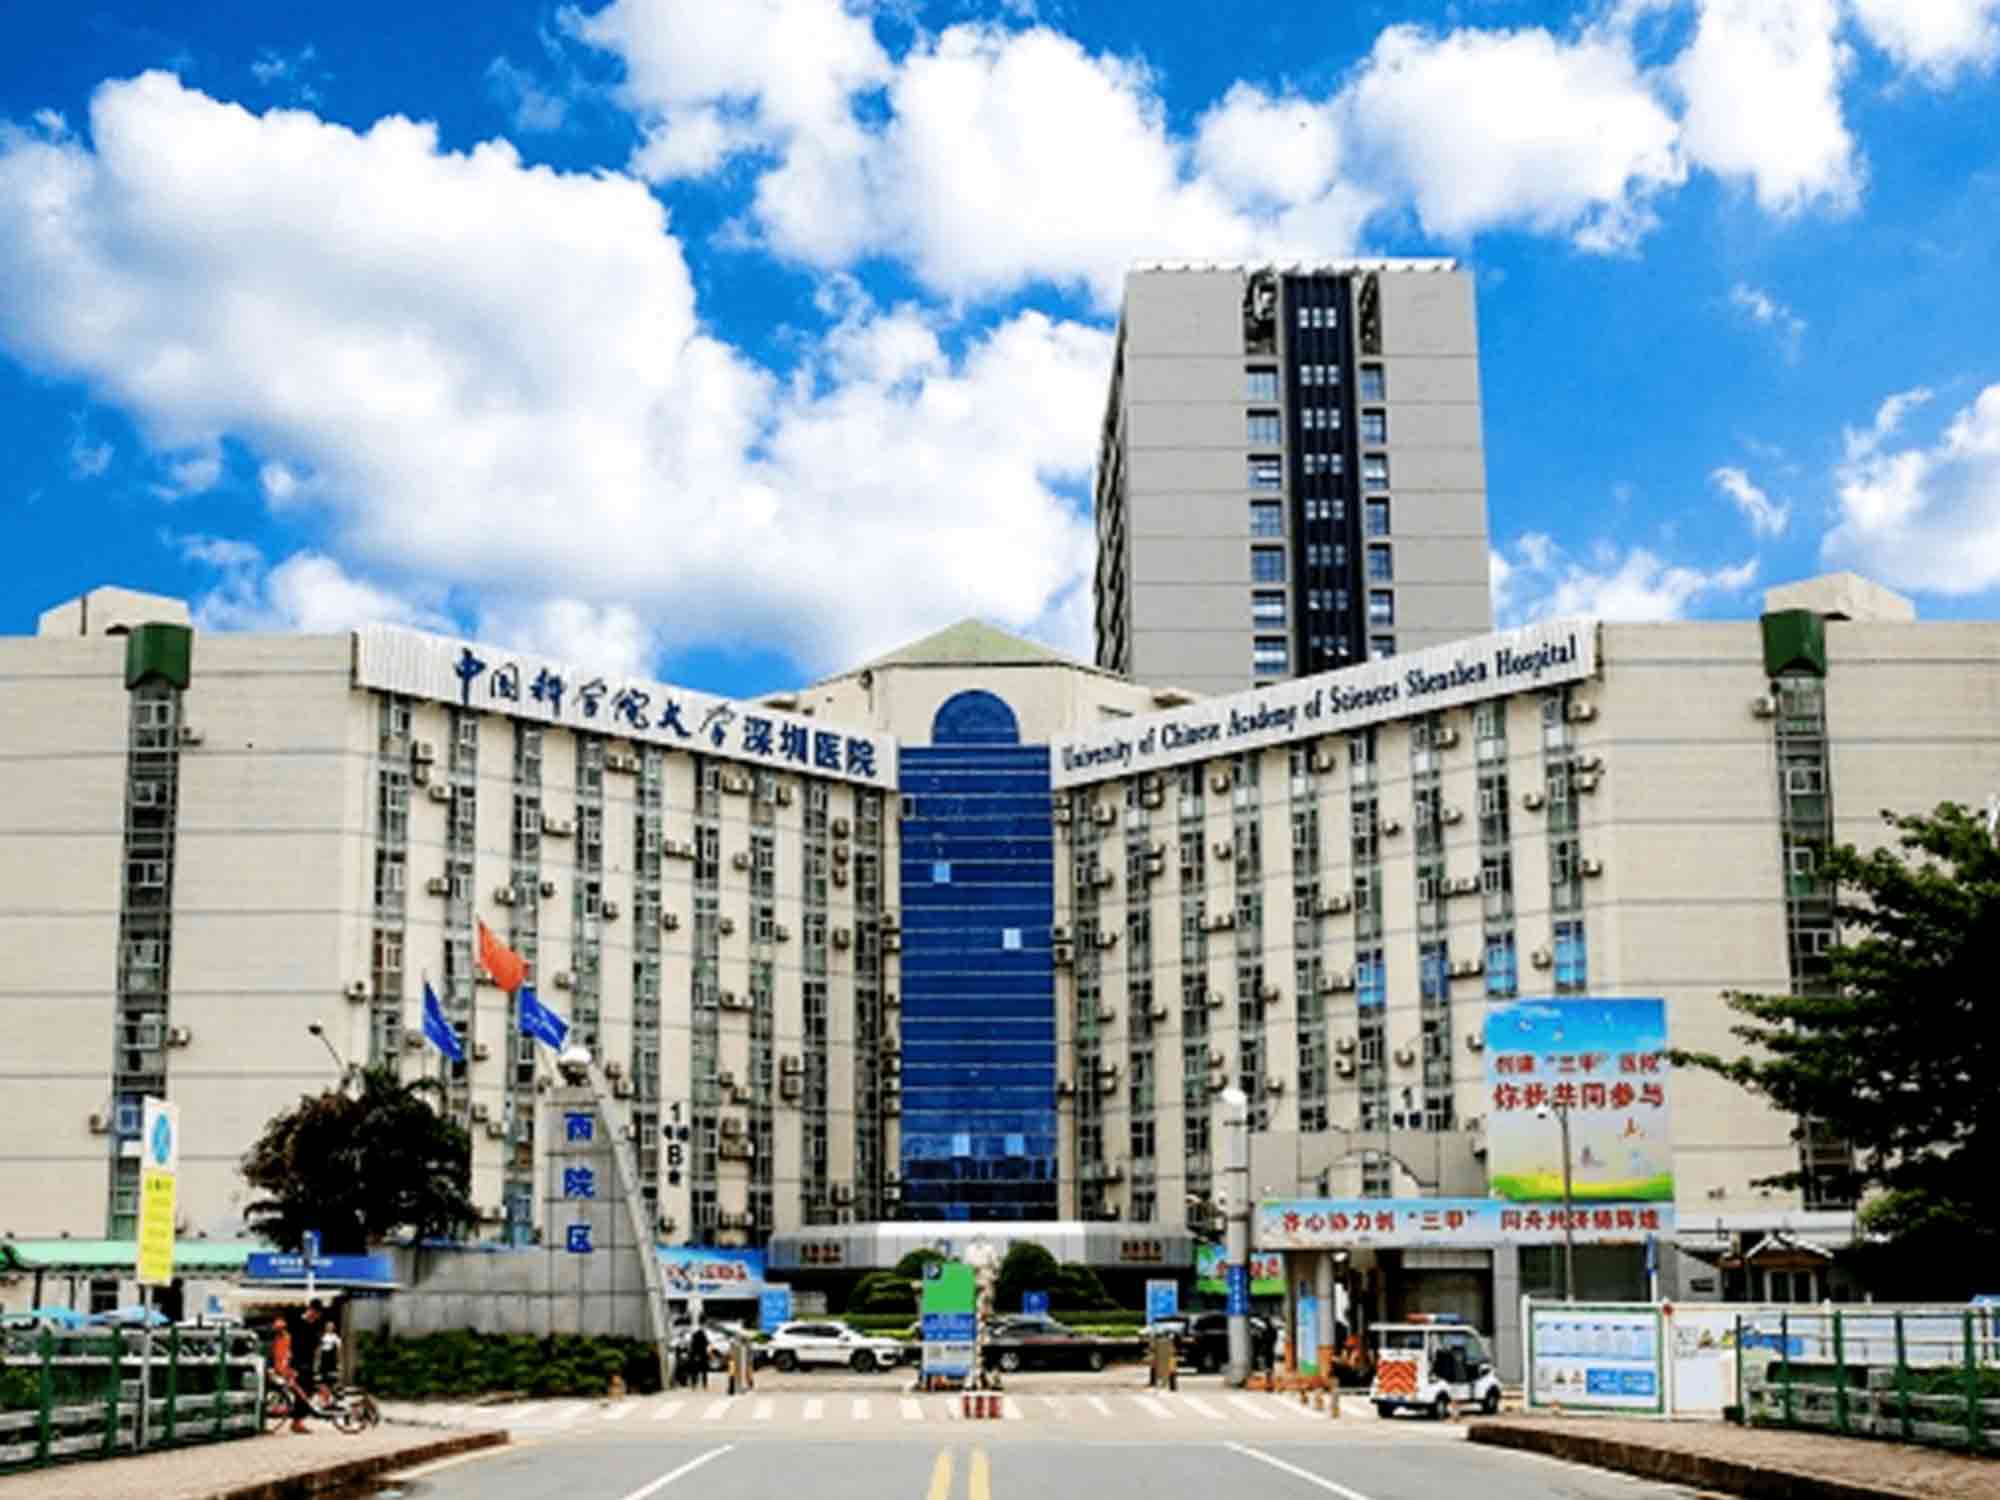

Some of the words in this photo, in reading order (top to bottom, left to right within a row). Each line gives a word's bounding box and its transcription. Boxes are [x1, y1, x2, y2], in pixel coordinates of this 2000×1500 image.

[1062, 740, 1132, 771] University
[1139, 727, 1155, 754] of
[1162, 721, 1219, 749] Chinese
[1227, 701, 1297, 737] Academy
[1304, 689, 1323, 720] of
[1330, 682, 1398, 714] Sciences
[1405, 660, 1487, 697] Shenzhen
[1495, 633, 1575, 679] Hospital
